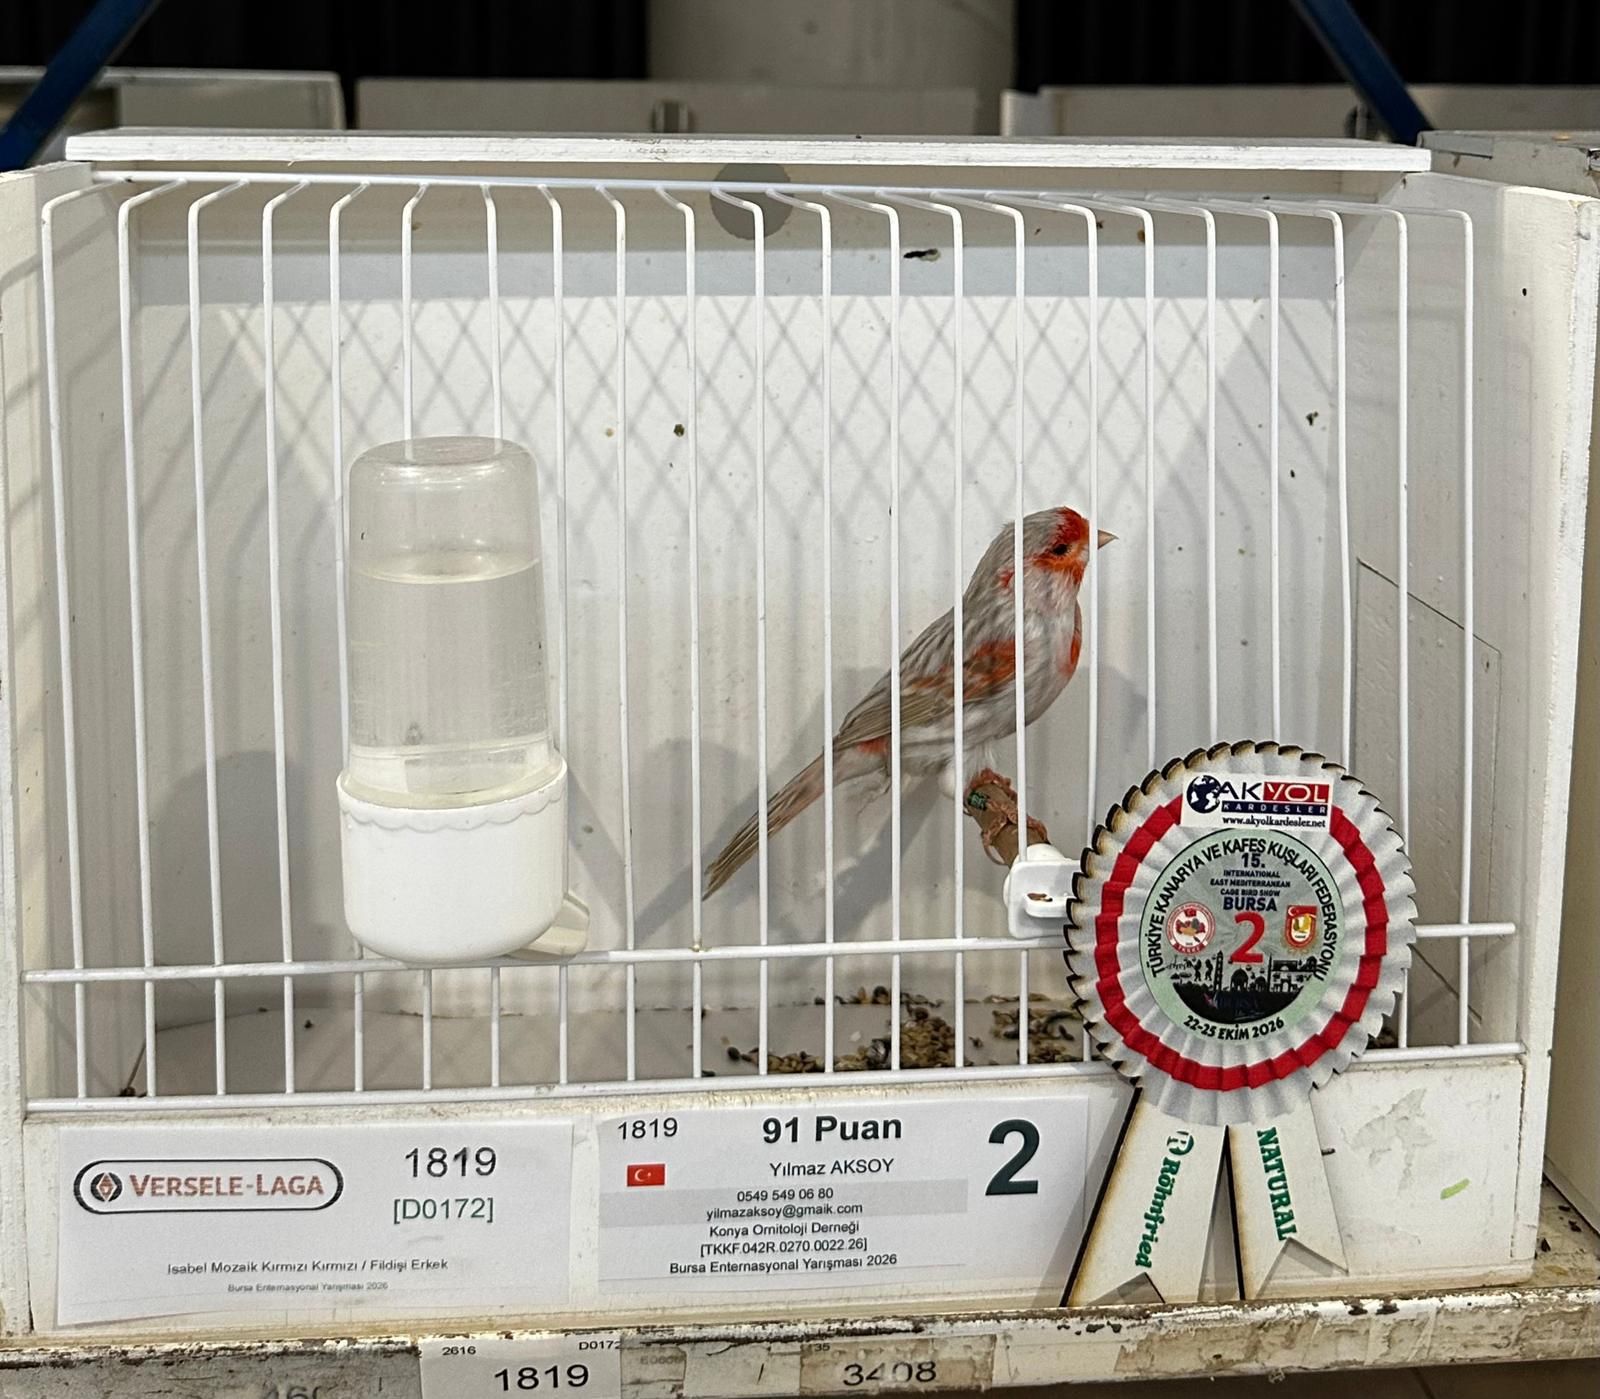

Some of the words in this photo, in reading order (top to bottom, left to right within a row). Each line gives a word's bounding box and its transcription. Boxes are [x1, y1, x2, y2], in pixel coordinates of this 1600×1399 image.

[1219, 781, 1327, 803] AKYOL
[1222, 803, 1327, 814] KARDESLER
[1222, 815, 1326, 828] www.akyolkardesler.net
[1201, 844, 1222, 862] VE
[1222, 838, 1266, 856] KAFES
[1241, 853, 1266, 868] 15.
[1267, 841, 1319, 882] KUŞLARI
[1153, 855, 1205, 913] KANARYA
[1210, 878, 1229, 886] EAST
[1230, 879, 1291, 887] MEDITERRANEAN
[1223, 870, 1281, 878] INTERNATIONAL
[1260, 889, 1281, 897] SHOW
[1223, 896, 1277, 911] BURSA
[1230, 912, 1265, 965] 2
[1312, 878, 1337, 981] FEDERASYONU
[1145, 913, 1165, 978] TÜRKİYE
[1183, 1015, 1216, 1038] 22-25
[1217, 1022, 1250, 1041] EKİM
[1251, 1016, 1285, 1038] 2026
[617, 1117, 678, 1140] 1819
[763, 1117, 799, 1144] 91
[815, 1115, 902, 1142] Puan
[405, 1147, 497, 1177] 1819
[769, 1162, 826, 1177] Yılmaz
[830, 1158, 894, 1175] AKSOY
[985, 1119, 1040, 1196] 2
[129, 1174, 324, 1197] VERSELE-LAGA
[1256, 1127, 1297, 1241] NATURAL
[737, 1190, 768, 1202] 0549
[772, 1189, 795, 1201] 549
[799, 1188, 814, 1200] 06
[818, 1187, 834, 1199] 80
[394, 1197, 494, 1225] [D0172]
[706, 1203, 863, 1221] yilmazaksoy@gmaik.com
[1135, 1156, 1181, 1268] Röhnfried
[709, 1225, 749, 1239] Konya
[753, 1223, 808, 1237] Ornitoloji
[811, 1220, 860, 1236] Derneği
[167, 1262, 207, 1275] Isabel
[211, 1261, 258, 1274] Mozaik
[262, 1261, 308, 1273] Kırmızı
[312, 1260, 358, 1272] Kırmızı
[361, 1260, 367, 1271] /
[370, 1259, 407, 1273] Fildişi
[411, 1259, 448, 1270] Erkek
[670, 1262, 706, 1274] Bursa
[710, 1258, 799, 1274] Enternasyonal
[803, 1257, 863, 1271] Yarışması
[866, 1253, 897, 1266] 2026
[227, 1284, 253, 1292] Bursa
[366, 1281, 388, 1290] 2026
[441, 1346, 477, 1356] 2616
[494, 1364, 589, 1391] 1819
